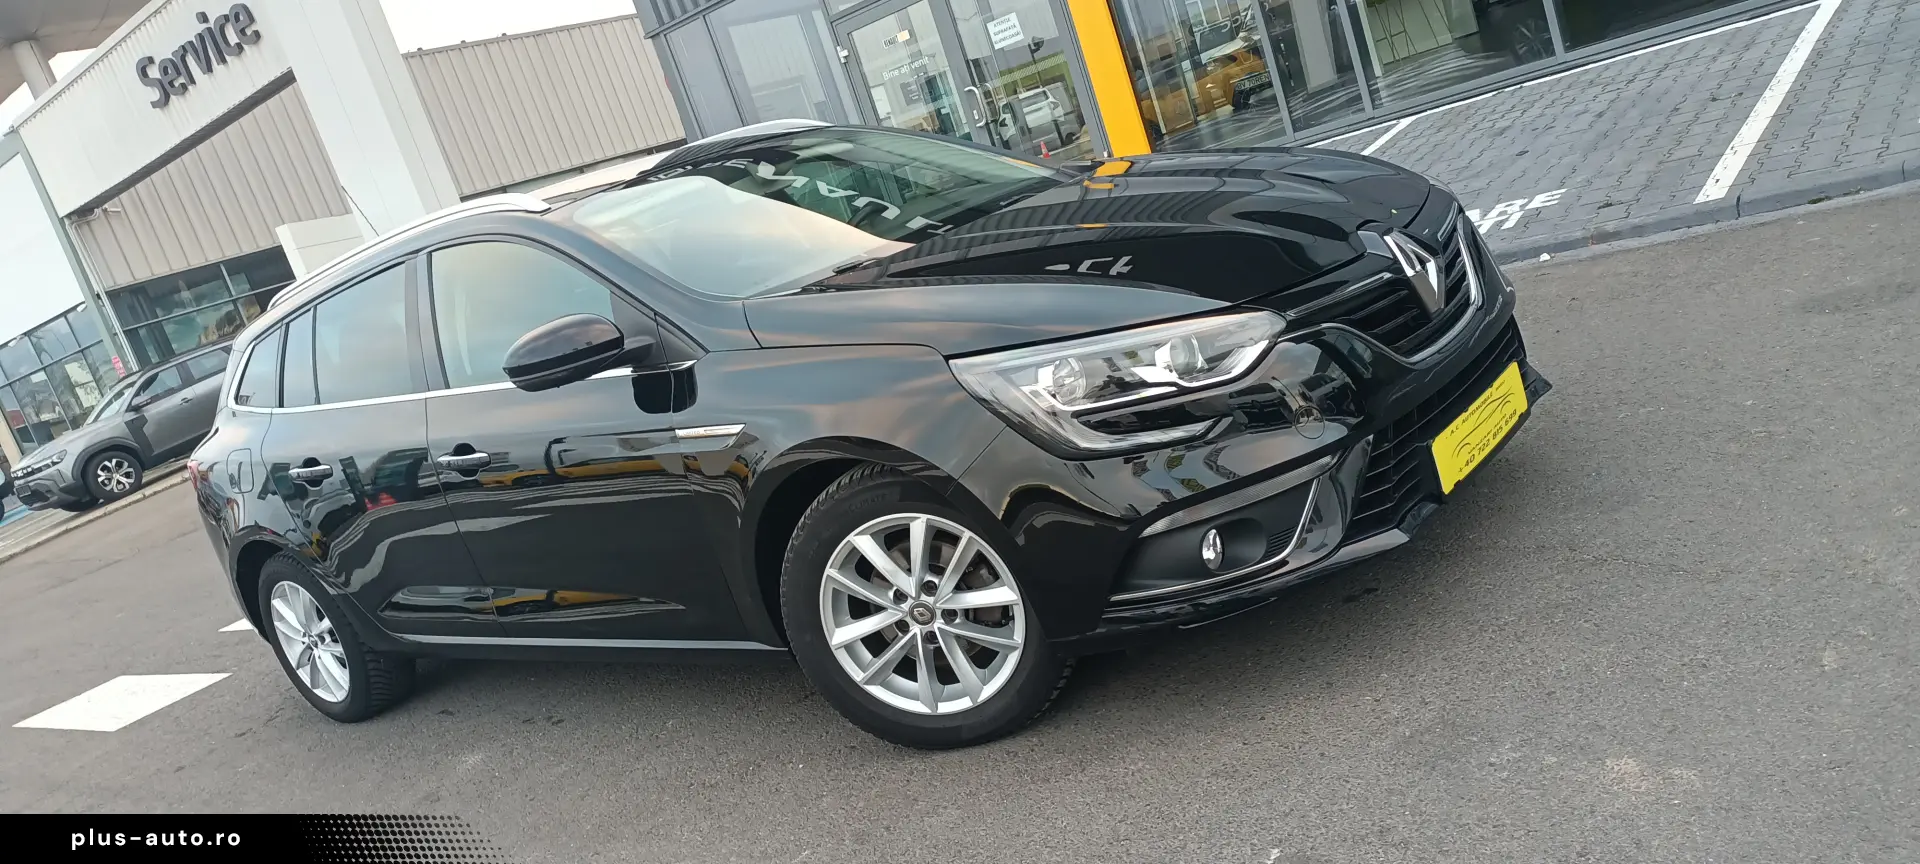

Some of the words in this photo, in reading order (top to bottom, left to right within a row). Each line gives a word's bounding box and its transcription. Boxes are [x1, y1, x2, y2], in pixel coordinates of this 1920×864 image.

[136, 3, 261, 109] Service
[882, 70, 899, 81] Bine
[911, 55, 930, 69] venit
[1461, 391, 1493, 425] AUTOMOBILE
[1478, 439, 1491, 456] 722
[1492, 426, 1504, 440] 815
[1504, 408, 1517, 427] 699
